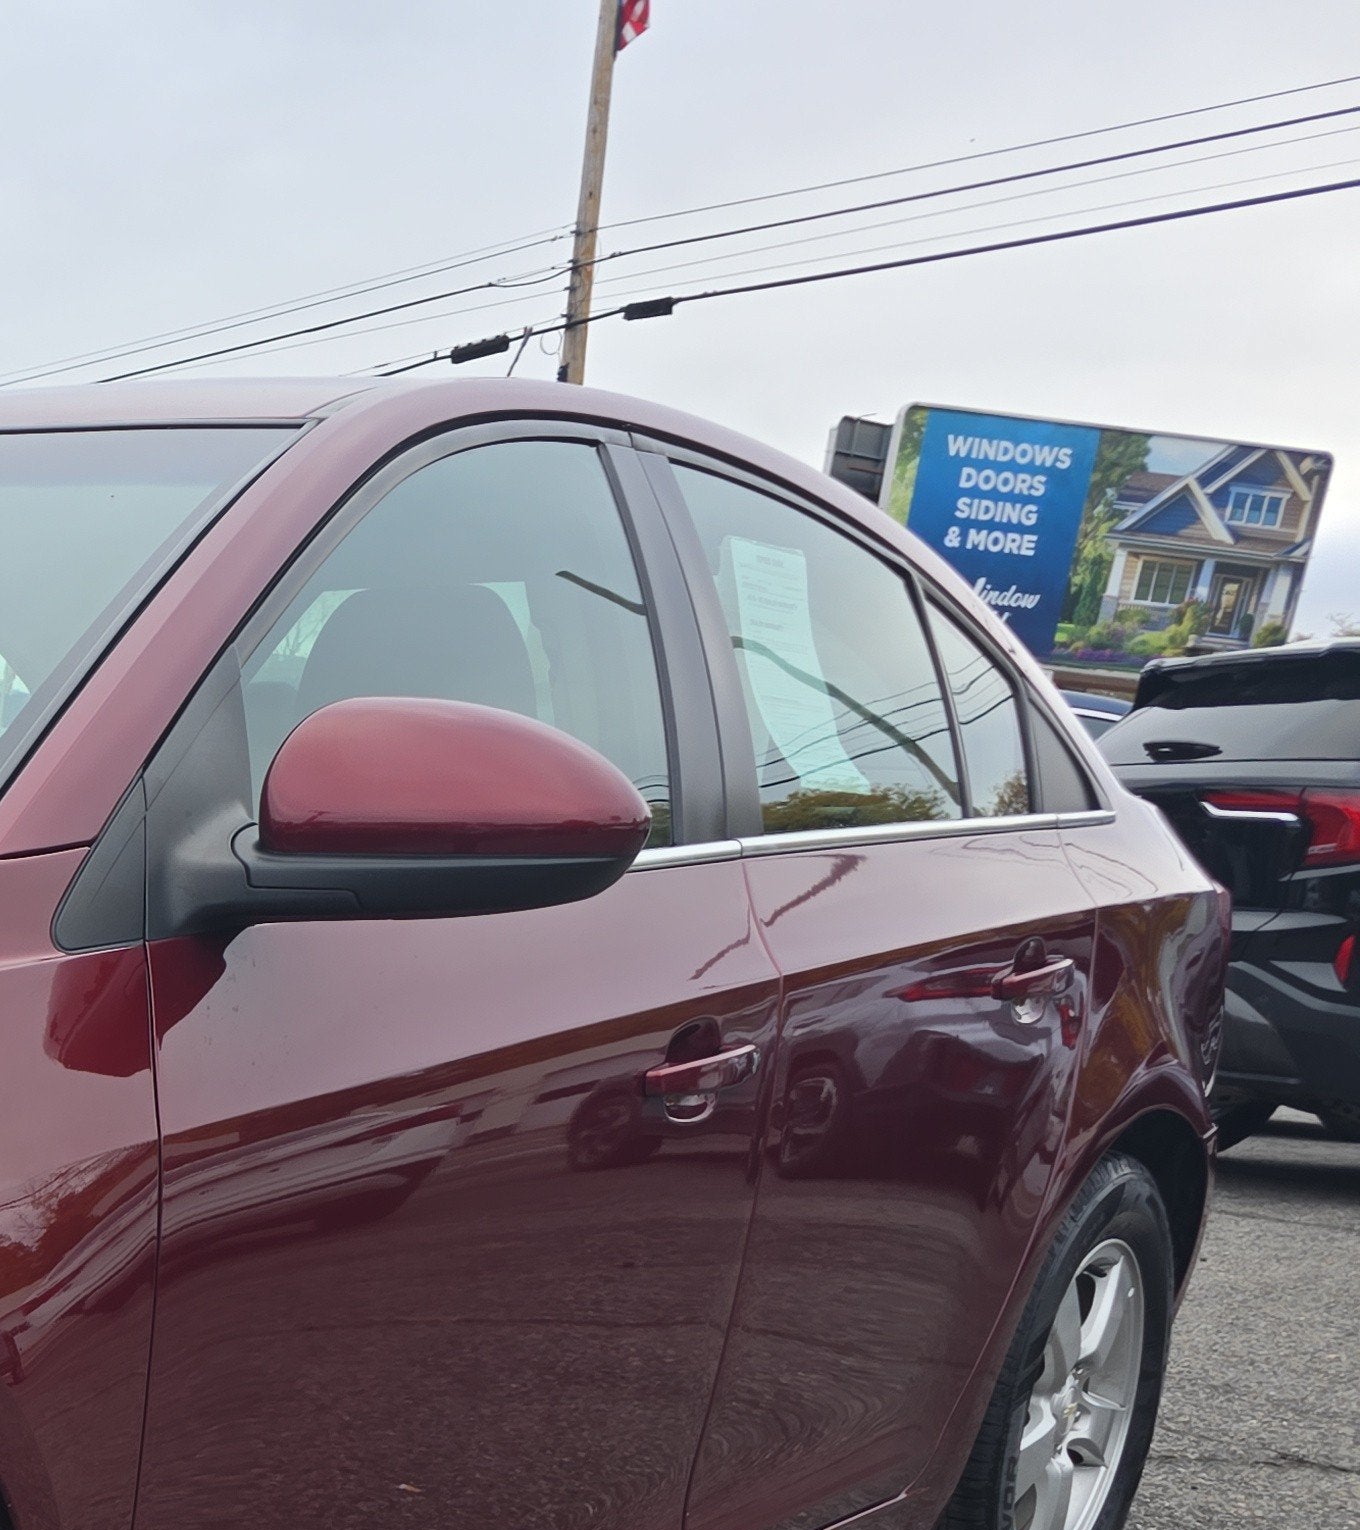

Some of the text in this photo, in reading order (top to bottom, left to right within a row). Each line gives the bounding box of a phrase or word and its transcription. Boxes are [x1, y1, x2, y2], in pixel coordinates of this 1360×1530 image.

[948, 434, 1073, 469] WINDOWS
[959, 467, 1047, 496] DOORS
[954, 497, 1038, 526] SIDING
[943, 526, 1038, 556] & MORE
